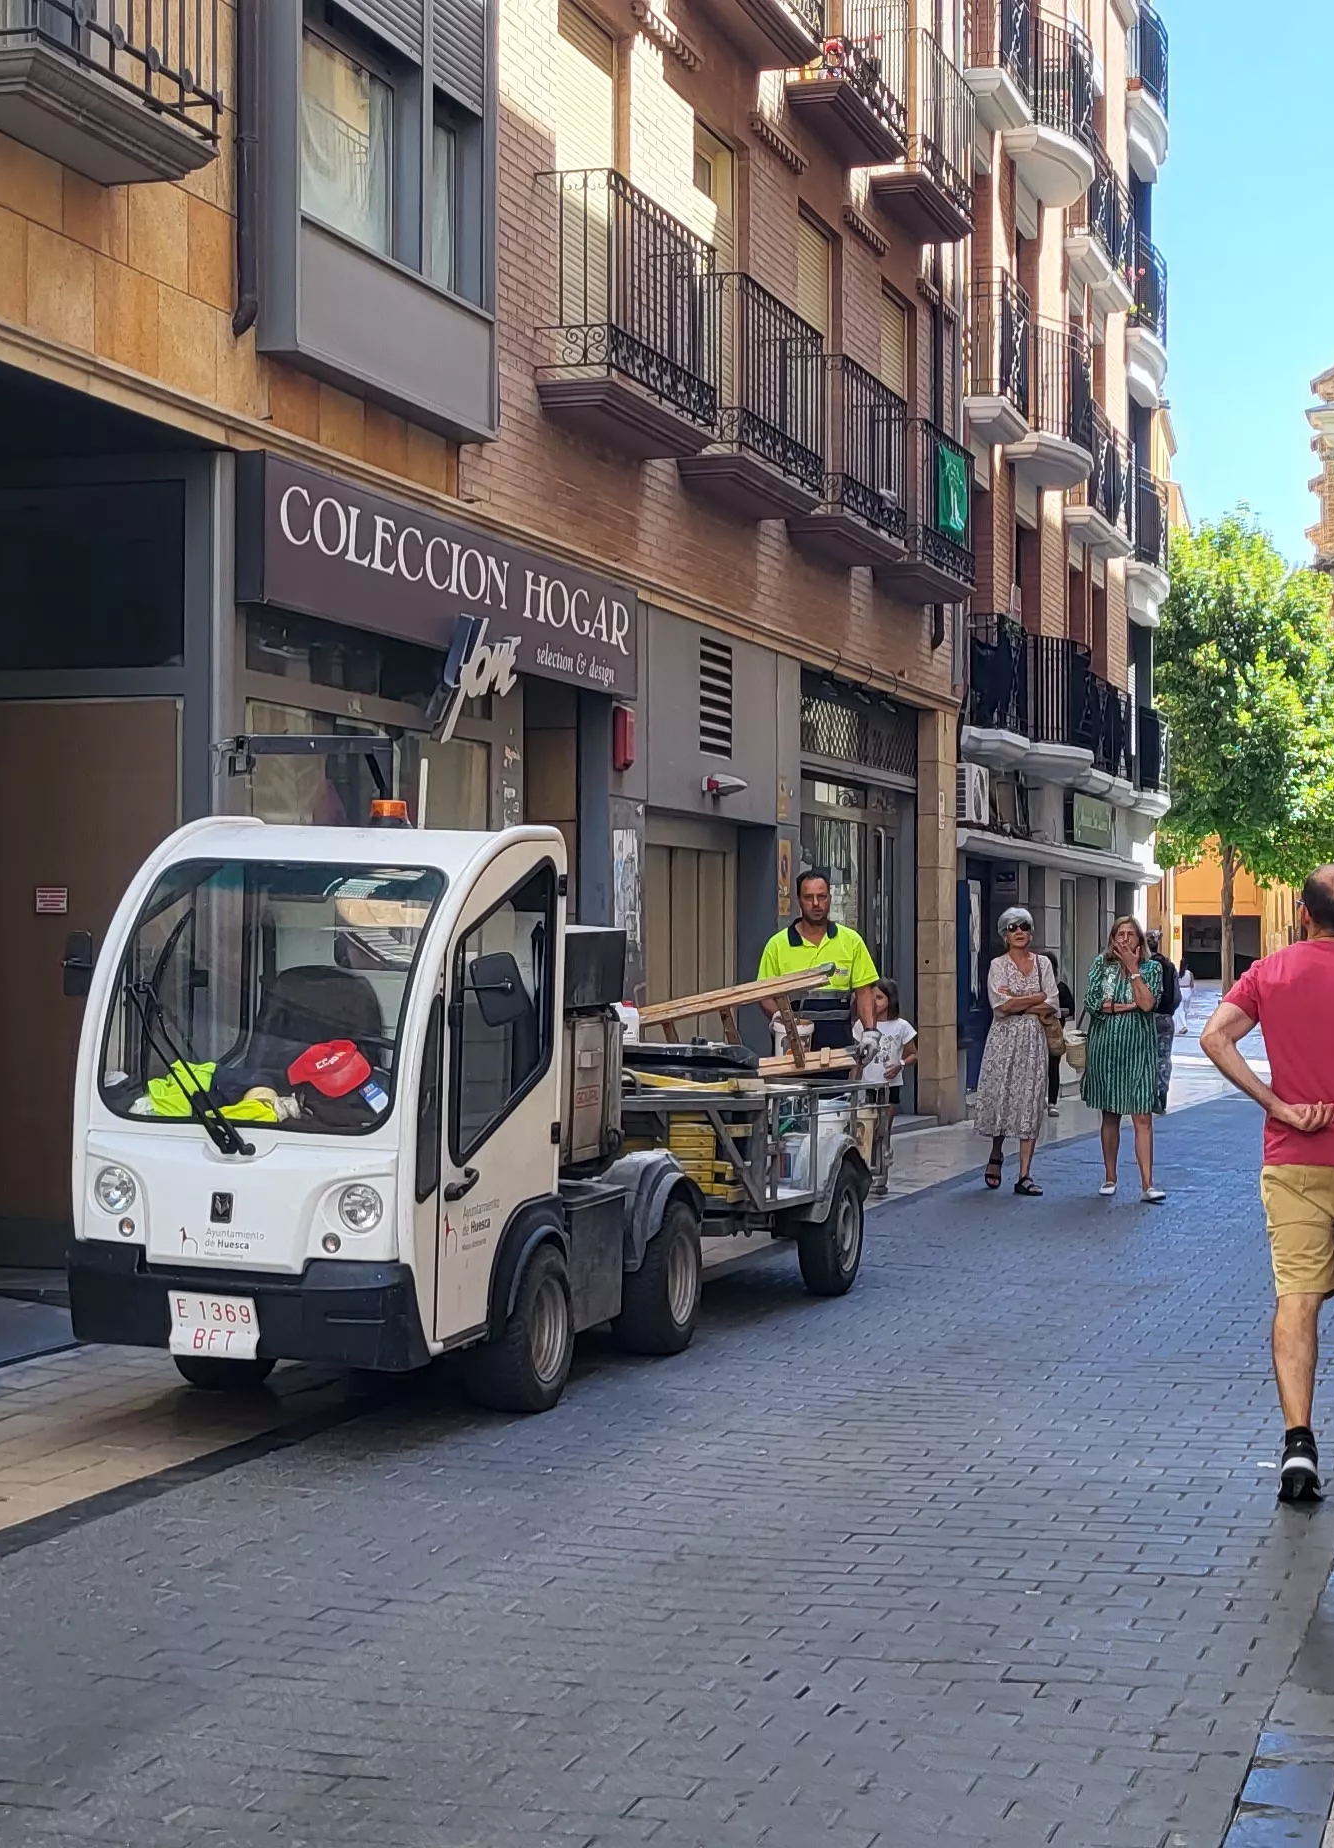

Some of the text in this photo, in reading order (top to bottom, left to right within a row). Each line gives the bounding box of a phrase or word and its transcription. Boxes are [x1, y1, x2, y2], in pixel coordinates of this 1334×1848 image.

[280, 486, 629, 655] COLECCION HOGAR
[536, 643, 615, 687] selection & design
[205, 1227, 265, 1241] Ayuntamiento
[471, 1218, 491, 1234] Huesca
[204, 1239, 250, 1250] de Huesca
[177, 1298, 251, 1324] E 1369
[193, 1328, 236, 1351] BFT
